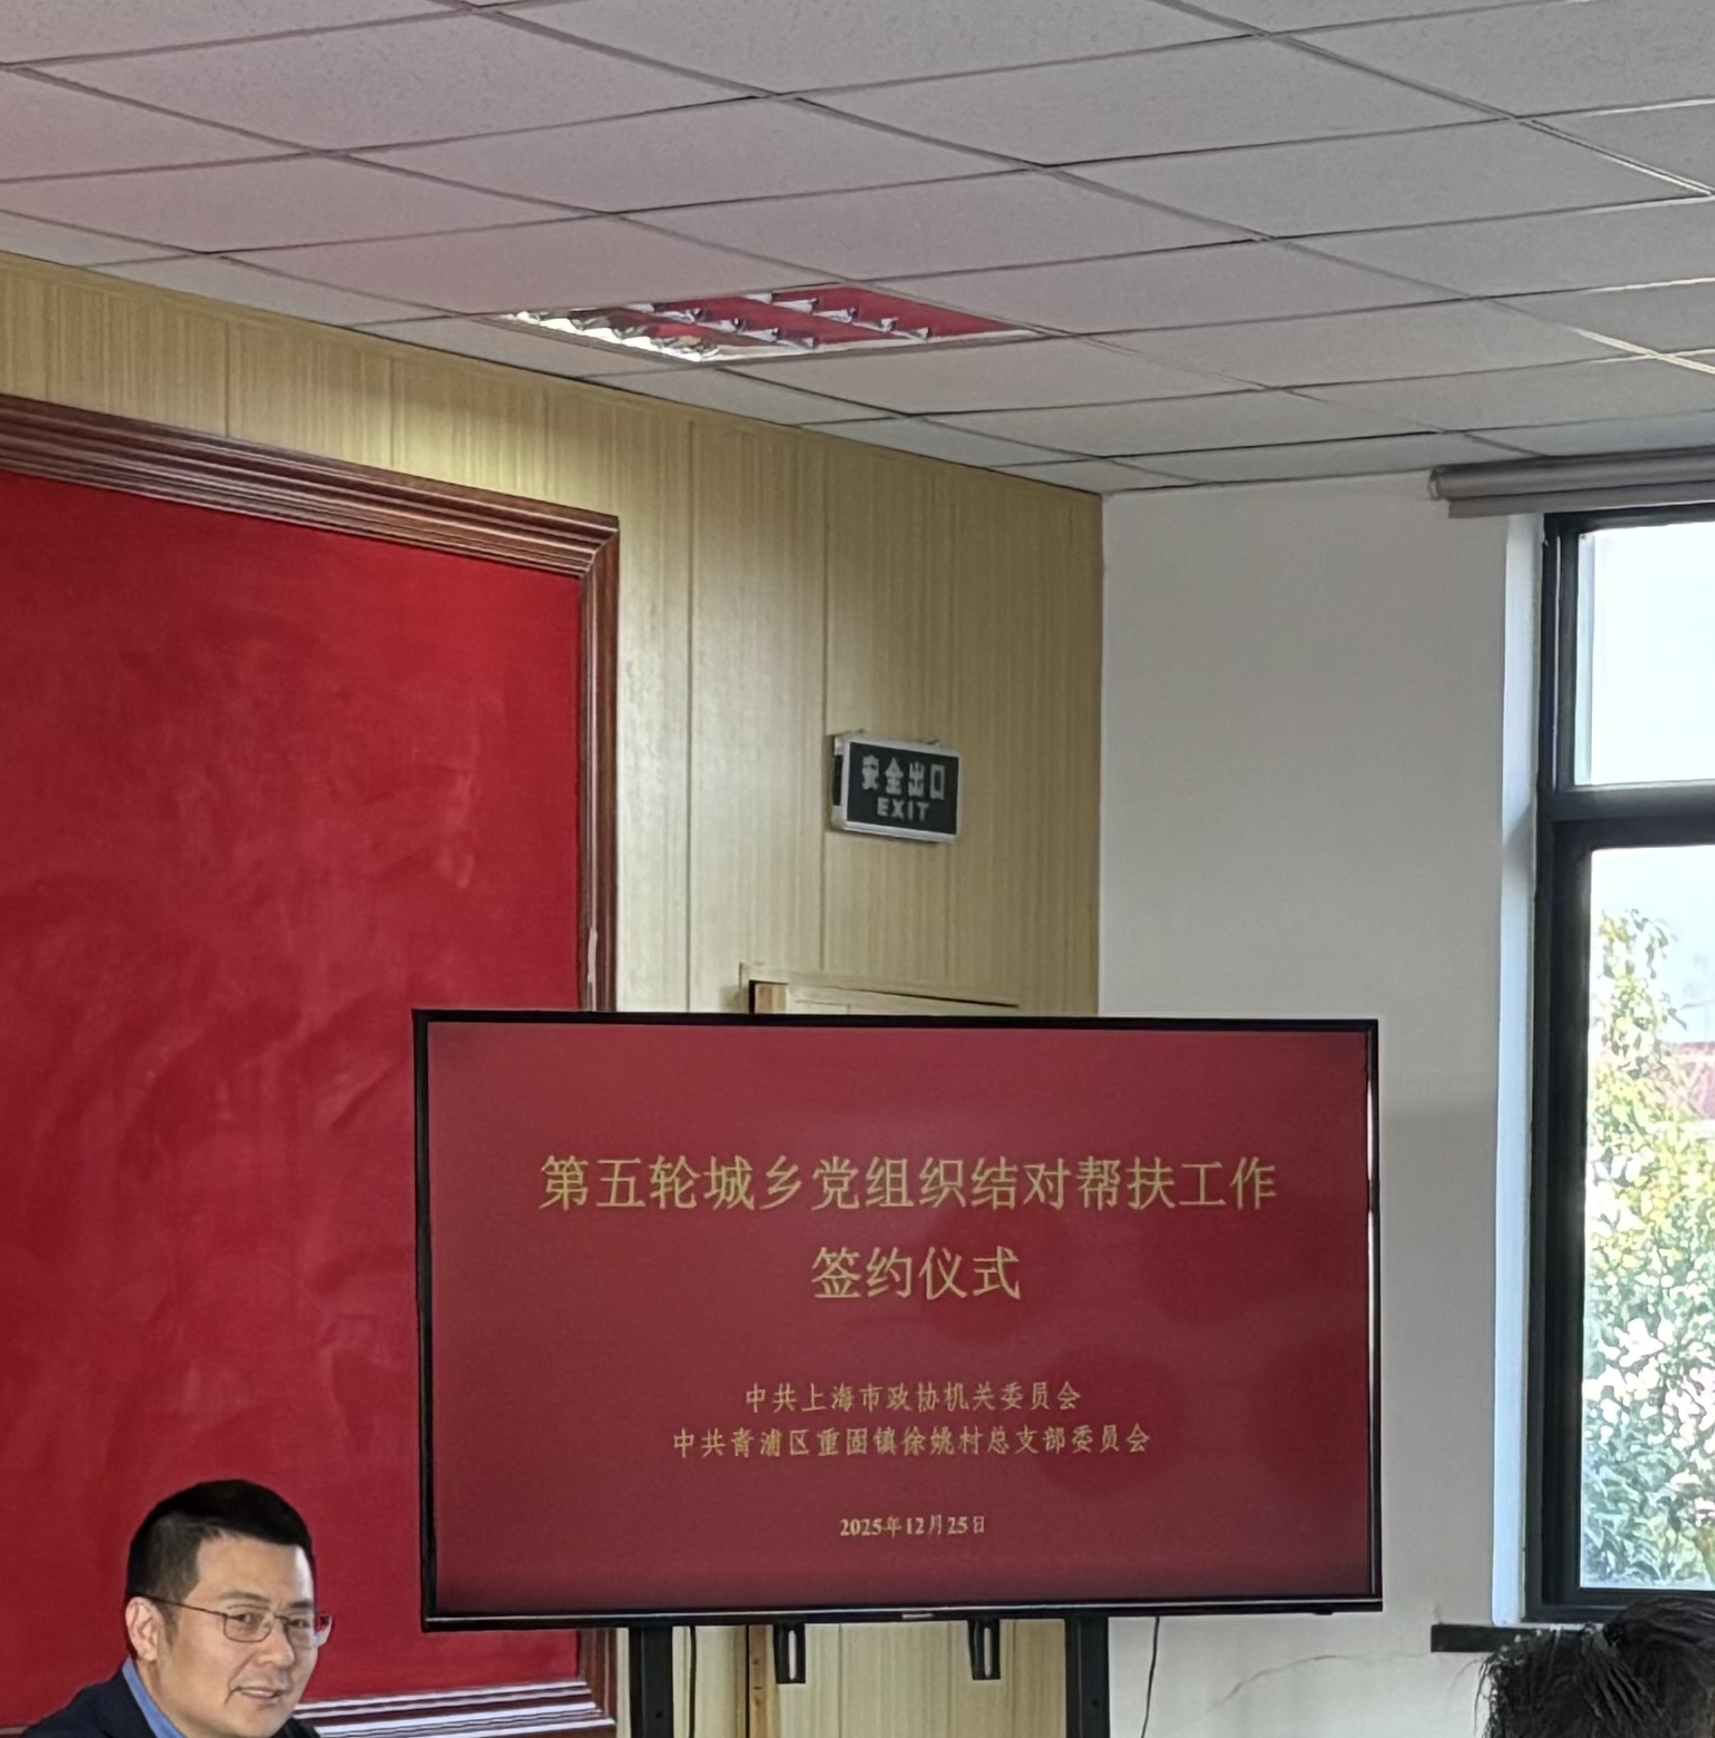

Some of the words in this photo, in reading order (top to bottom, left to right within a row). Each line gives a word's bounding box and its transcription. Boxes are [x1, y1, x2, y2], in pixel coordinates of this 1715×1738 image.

[861, 754, 945, 800] 安全出口
[877, 797, 930, 822] EXIT
[538, 1154, 1278, 1211] 第五轮城乡党组织结对帮扶工作
[810, 1245, 1022, 1300] 签约仪式
[745, 1380, 1082, 1414] 中共上海市政协机关委员会
[673, 1423, 1151, 1459] 中共青浦区重固镇徐姚村总支部委员会
[839, 1514, 986, 1538] 2025年12月25日
